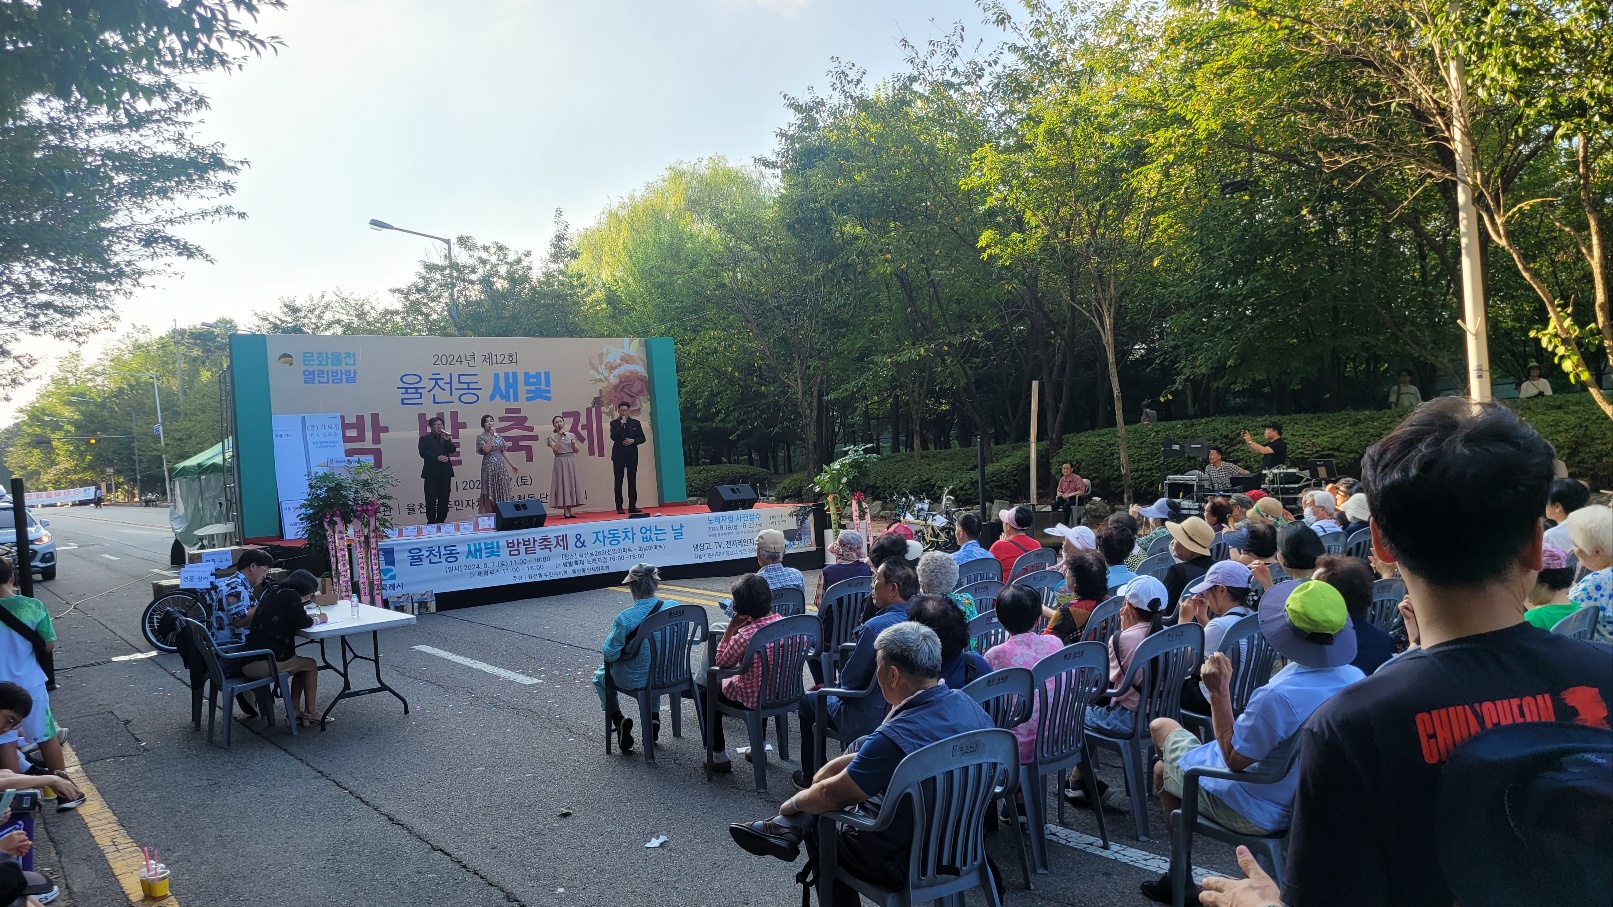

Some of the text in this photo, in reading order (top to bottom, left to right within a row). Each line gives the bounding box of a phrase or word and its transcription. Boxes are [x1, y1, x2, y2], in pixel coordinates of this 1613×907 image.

[302, 351, 356, 367] 문화율천
[432, 351, 518, 367] 2024년 제12회
[303, 369, 357, 384] 열린밤밭
[396, 370, 552, 406] 율천동 새빛
[406, 502, 427, 515] 율천
[407, 545, 460, 566] 율천동
[465, 540, 501, 560] 새빛
[505, 533, 569, 557] 밤밭축제
[574, 533, 587, 549] &
[592, 526, 636, 546] 자동차
[640, 524, 667, 543] 없는
[671, 523, 685, 540] 날
